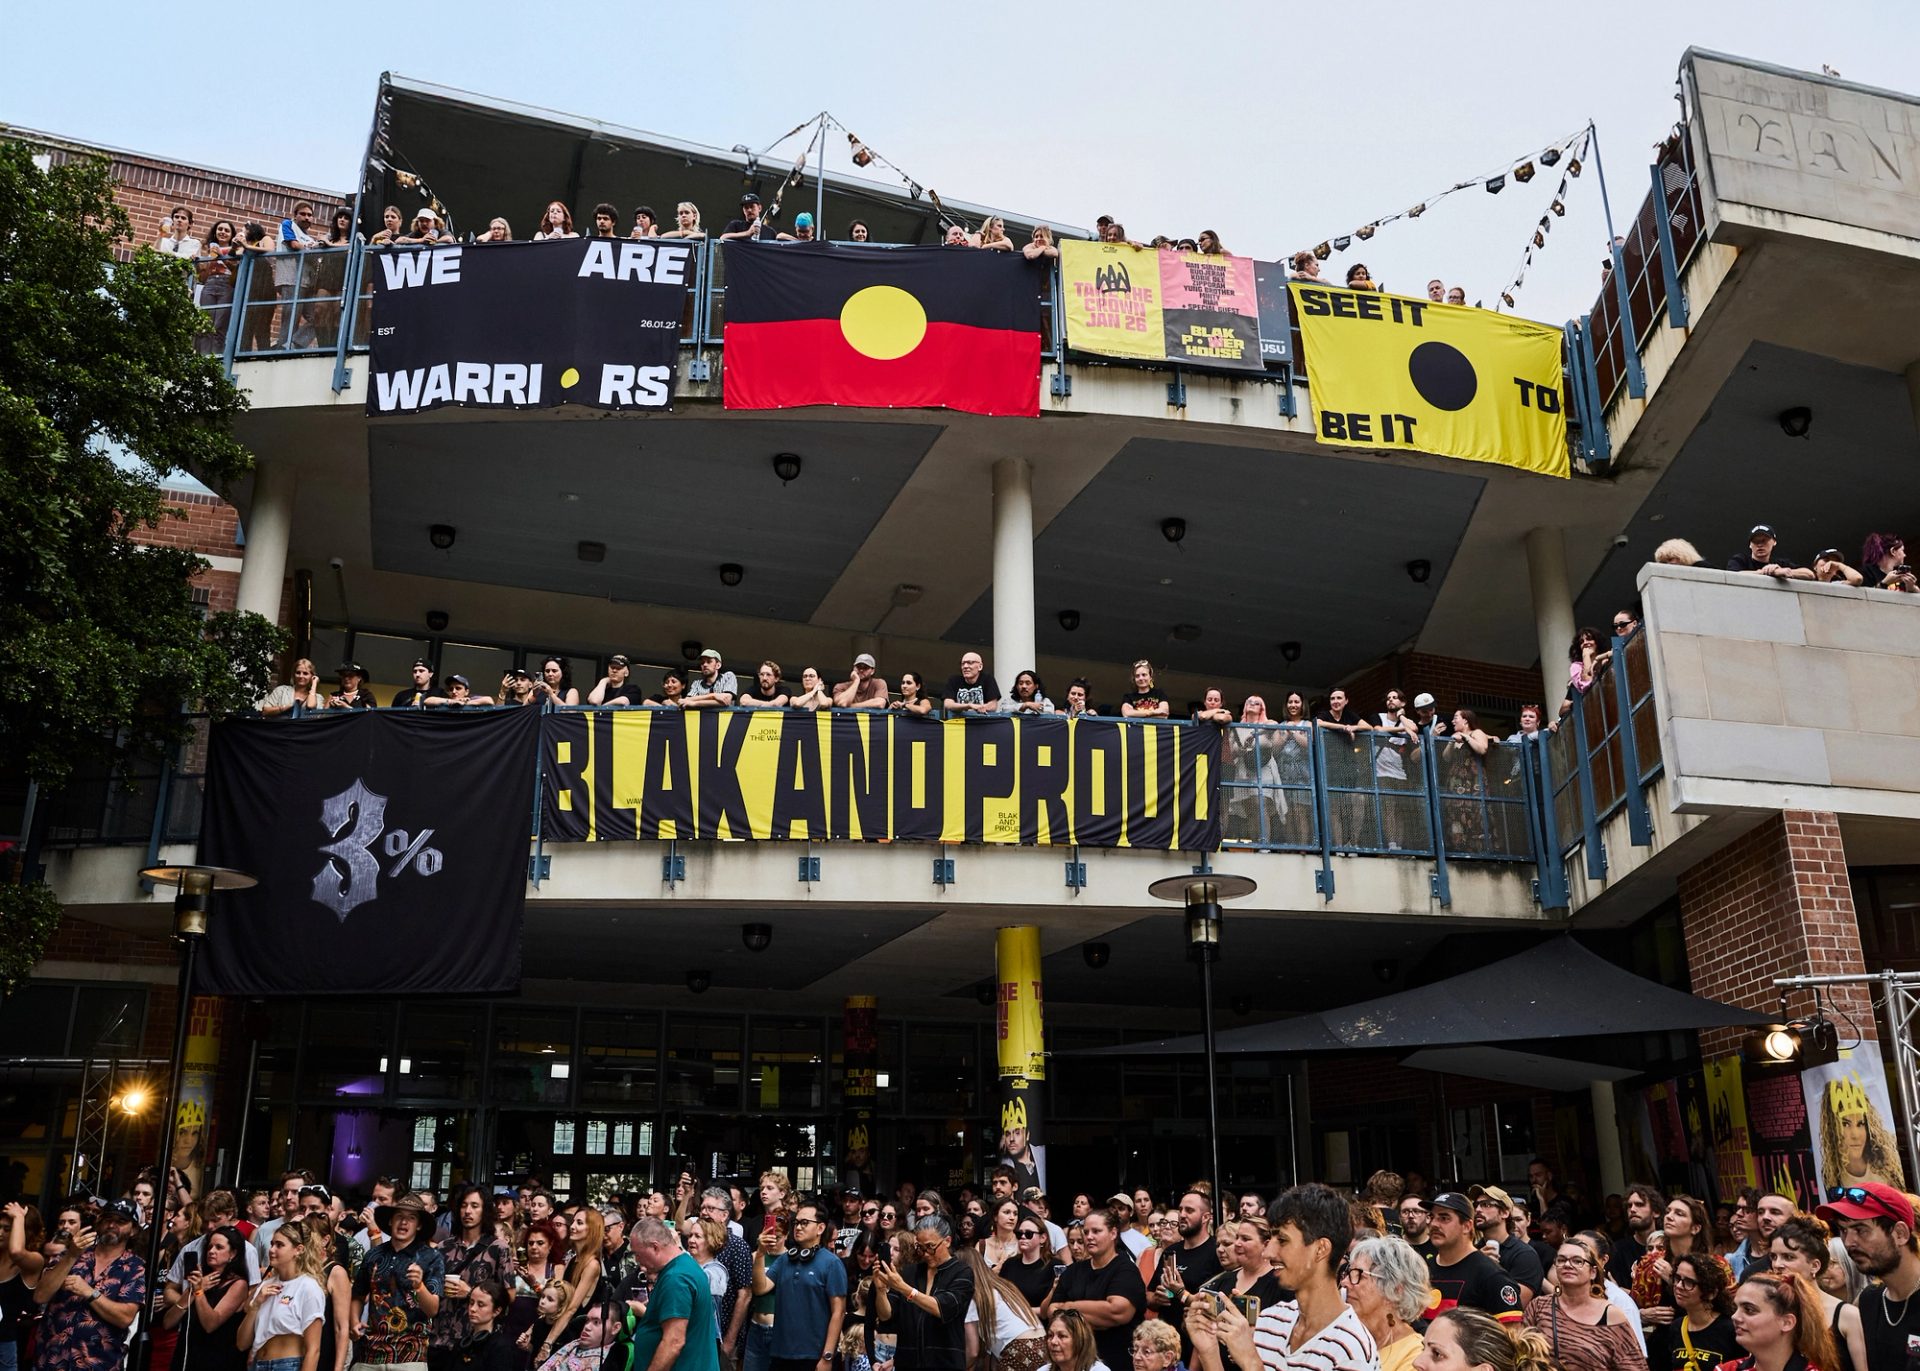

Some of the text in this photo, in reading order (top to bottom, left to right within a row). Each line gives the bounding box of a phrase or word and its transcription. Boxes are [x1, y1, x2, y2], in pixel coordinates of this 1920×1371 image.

[380, 241, 689, 290] WE ARE
[1084, 298, 1147, 317] CROWN
[1086, 312, 1147, 332] JAN 26
[1300, 289, 1428, 327] SEE IT
[378, 326, 396, 336] EST
[1190, 325, 1235, 339] BLAK
[1186, 345, 1242, 359] HOUSE
[1513, 377, 1560, 414] TO
[1321, 410, 1417, 444] BE IT
[543, 711, 1222, 852] BLAK AND PROUD
[311, 777, 443, 924] 3%
